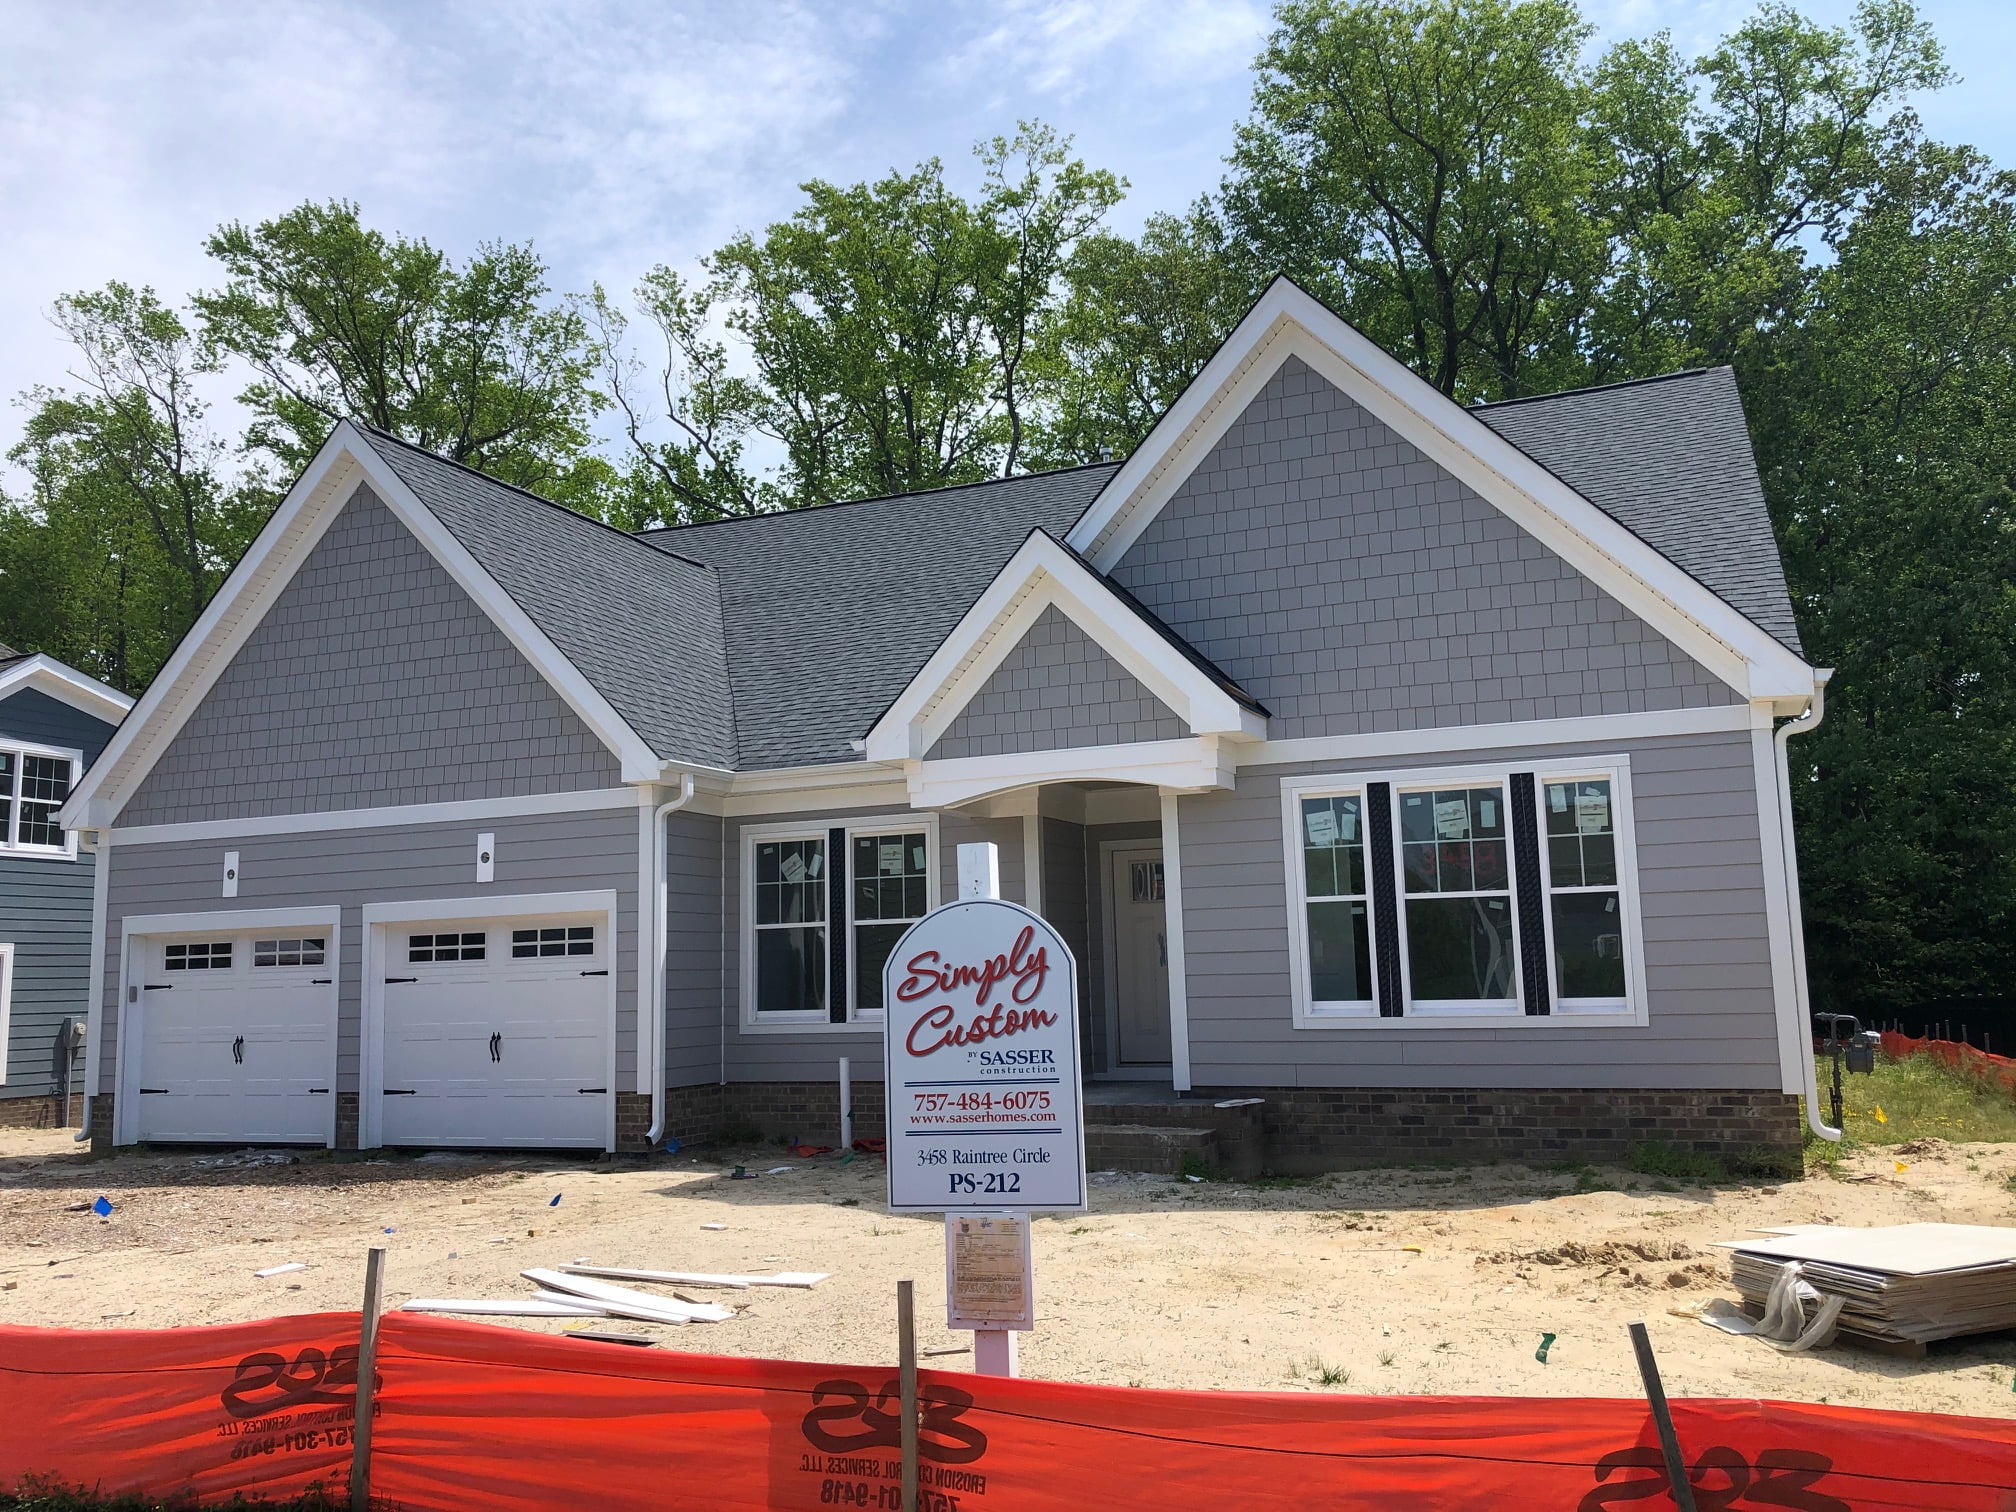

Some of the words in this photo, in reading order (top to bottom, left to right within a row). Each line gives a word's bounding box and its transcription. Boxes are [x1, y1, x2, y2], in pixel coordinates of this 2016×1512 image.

[897, 925, 1050, 1004] Simply
[905, 1003, 1058, 1057] Custom
[980, 1049, 1055, 1066] SASSER
[980, 1065, 1056, 1075] construction
[914, 1091, 1051, 1112] 757-484-6075
[910, 1111, 1057, 1124] www.sasserhomes.com
[917, 1149, 947, 1167] 3458
[952, 1148, 1008, 1165] Raintree
[1013, 1148, 1051, 1164] Circle
[948, 1172, 1021, 1194] PS-212
